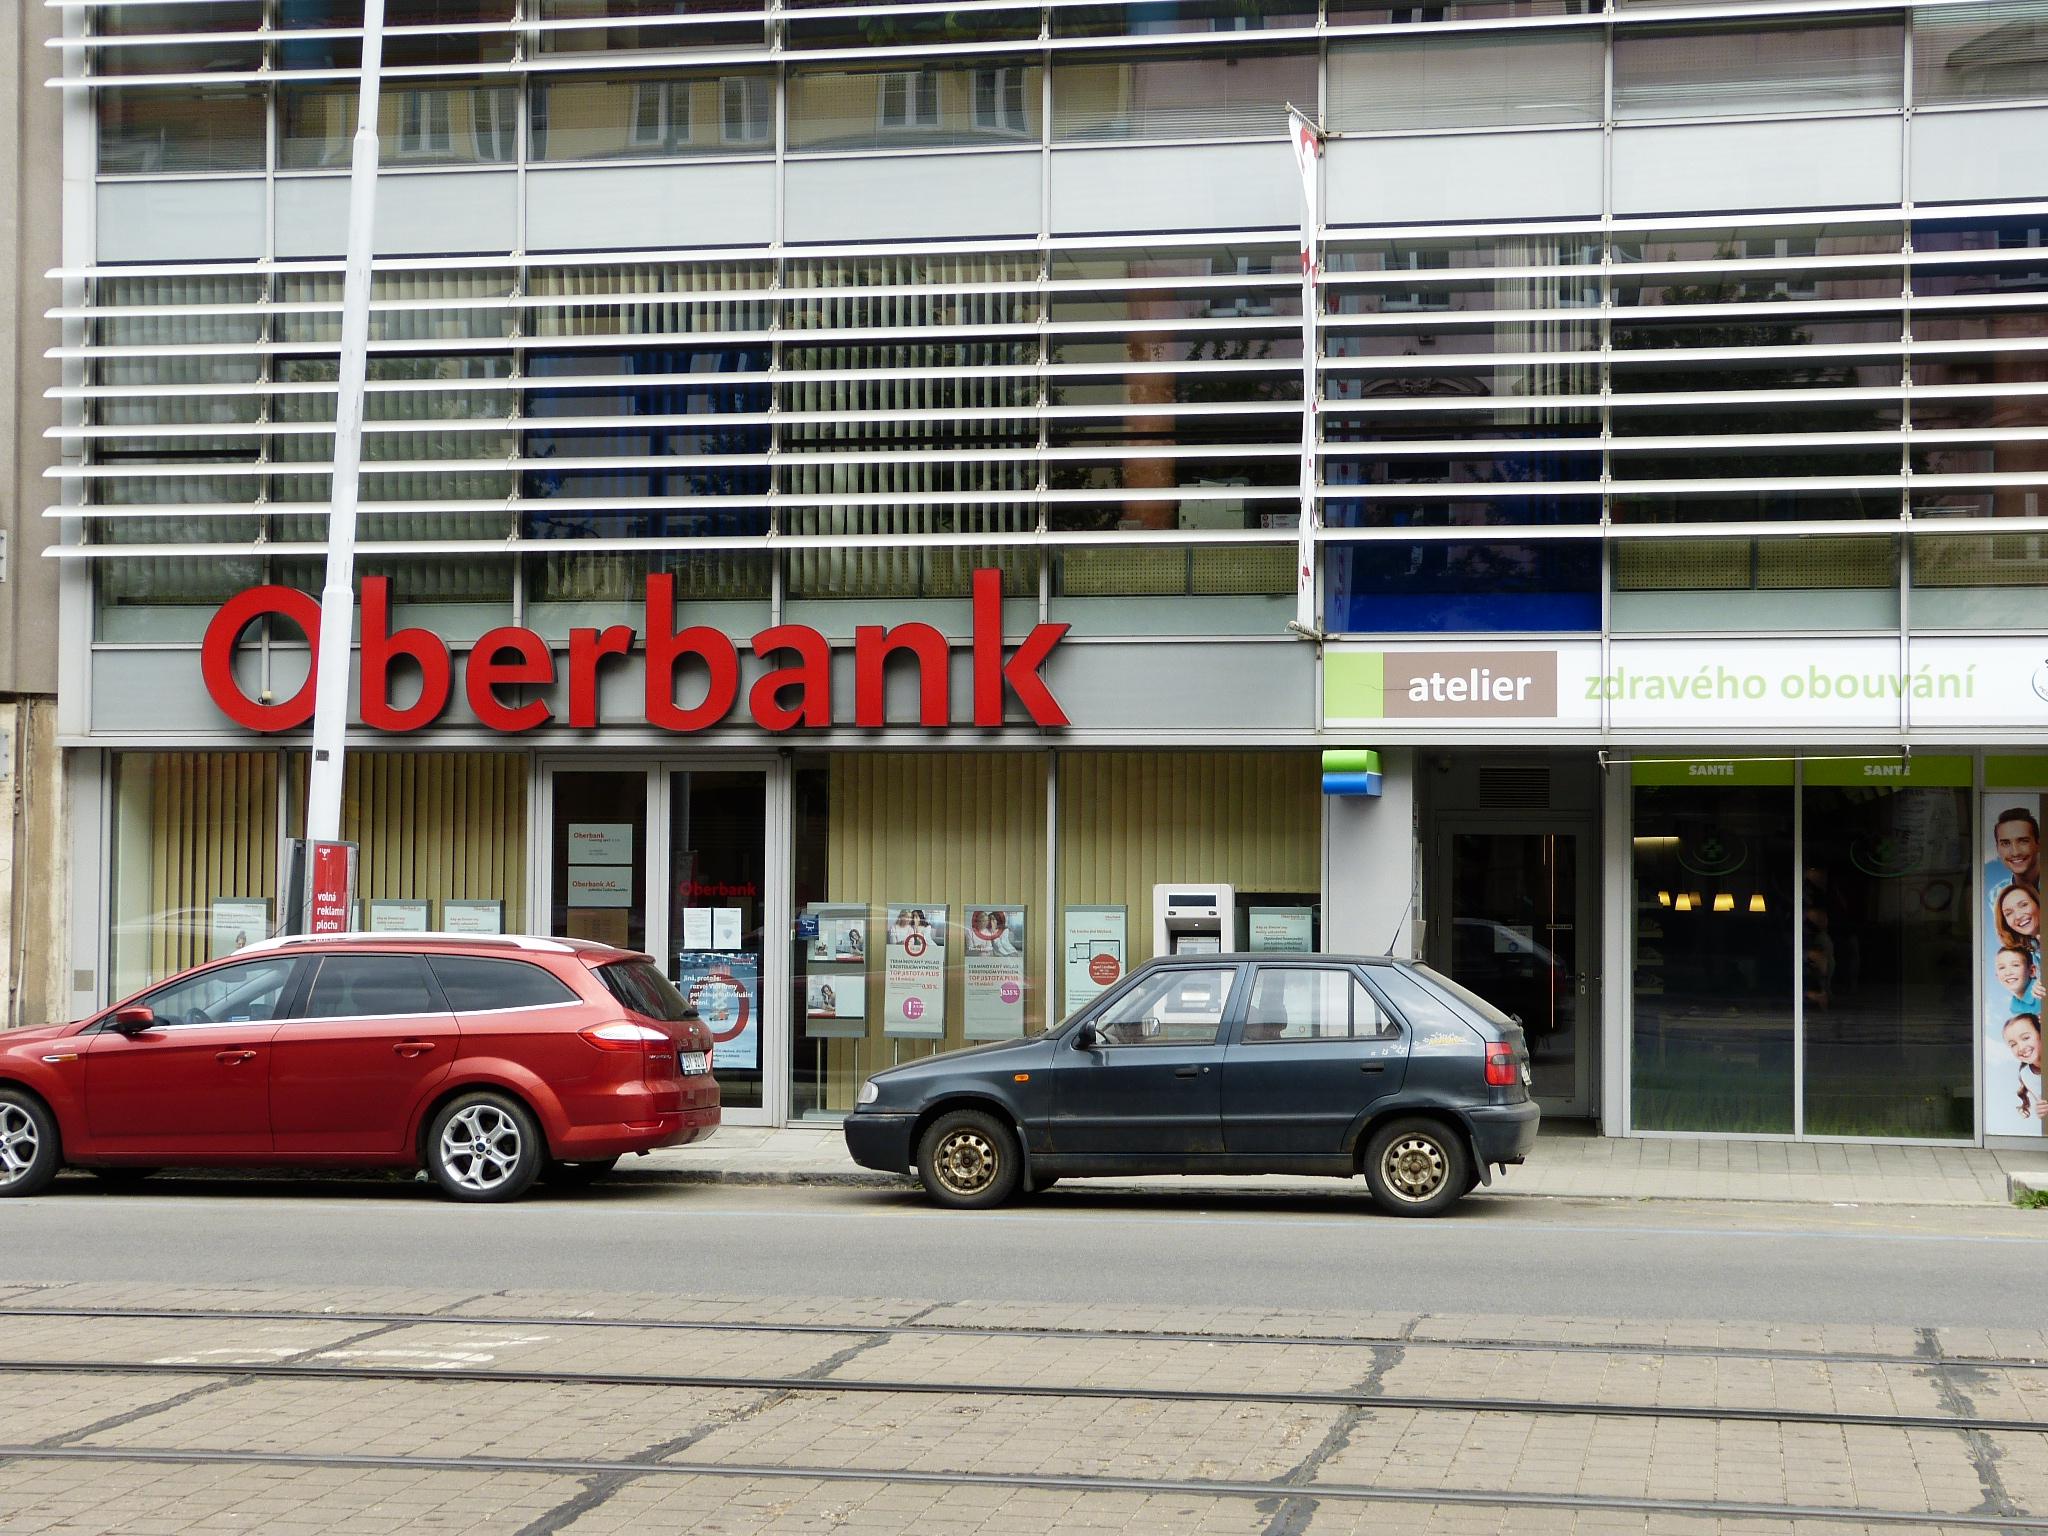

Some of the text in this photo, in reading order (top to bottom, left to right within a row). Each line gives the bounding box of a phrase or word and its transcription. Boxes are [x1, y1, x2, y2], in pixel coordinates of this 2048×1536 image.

[201, 568, 1070, 733] Oberbank
[1408, 665, 1533, 703] atelier
[1585, 664, 1976, 703] zdravého obouvání
[1688, 762, 1735, 776] SANTÉ
[680, 880, 757, 896] Oberbank
[317, 891, 337, 902] volná
[316, 905, 345, 916] reklamní
[316, 919, 339, 931] plocha
